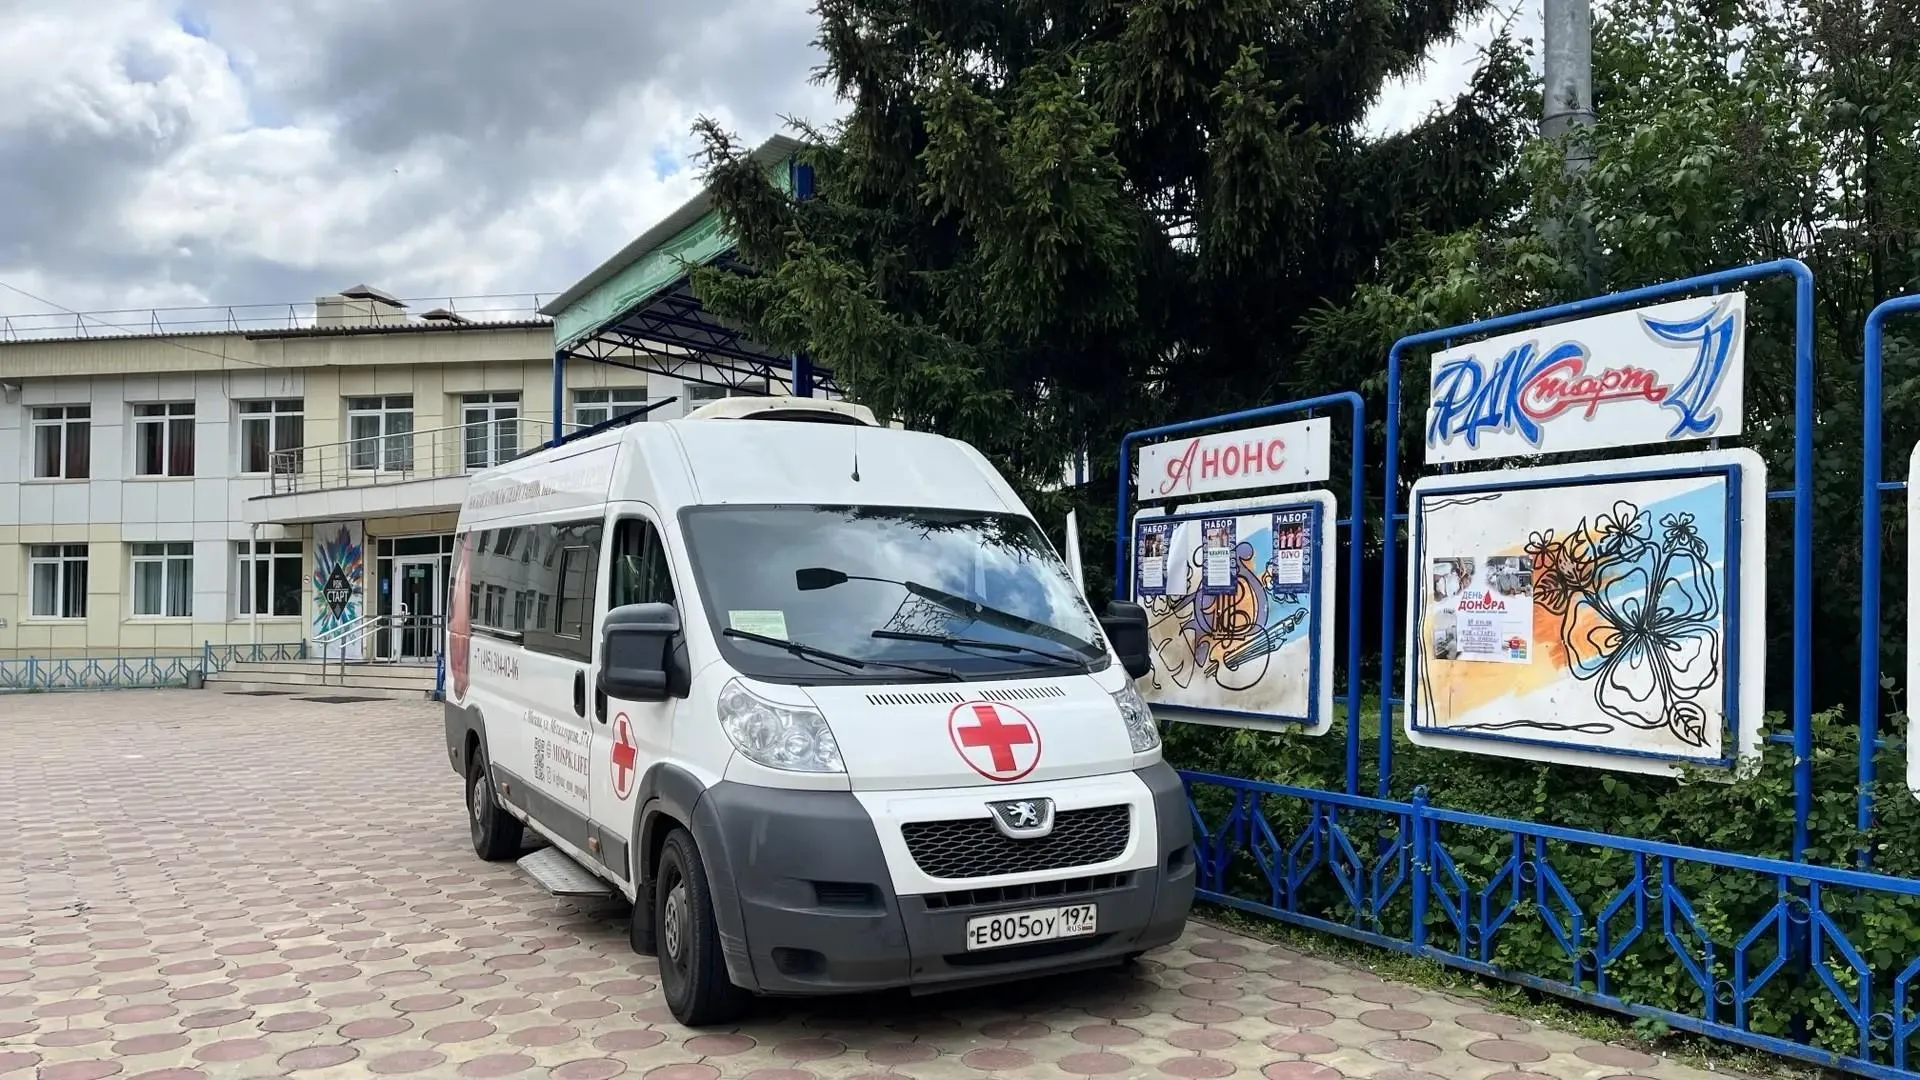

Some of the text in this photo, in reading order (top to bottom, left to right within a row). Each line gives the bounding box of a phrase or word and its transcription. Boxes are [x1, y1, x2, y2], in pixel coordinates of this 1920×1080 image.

[1428, 341, 1668, 447] РДК Старт
[1276, 512, 1308, 524] НАБОР
[1143, 524, 1168, 533] НАБОР
[1204, 519, 1233, 529] НАБОР
[327, 590, 348, 602] СТАРТ
[1462, 591, 1482, 600] ДЕНЬ
[1458, 600, 1505, 611] ДОНОРА
[976, 906, 1090, 945] Е805ОУ 197
[1066, 924, 1082, 932] RUS
